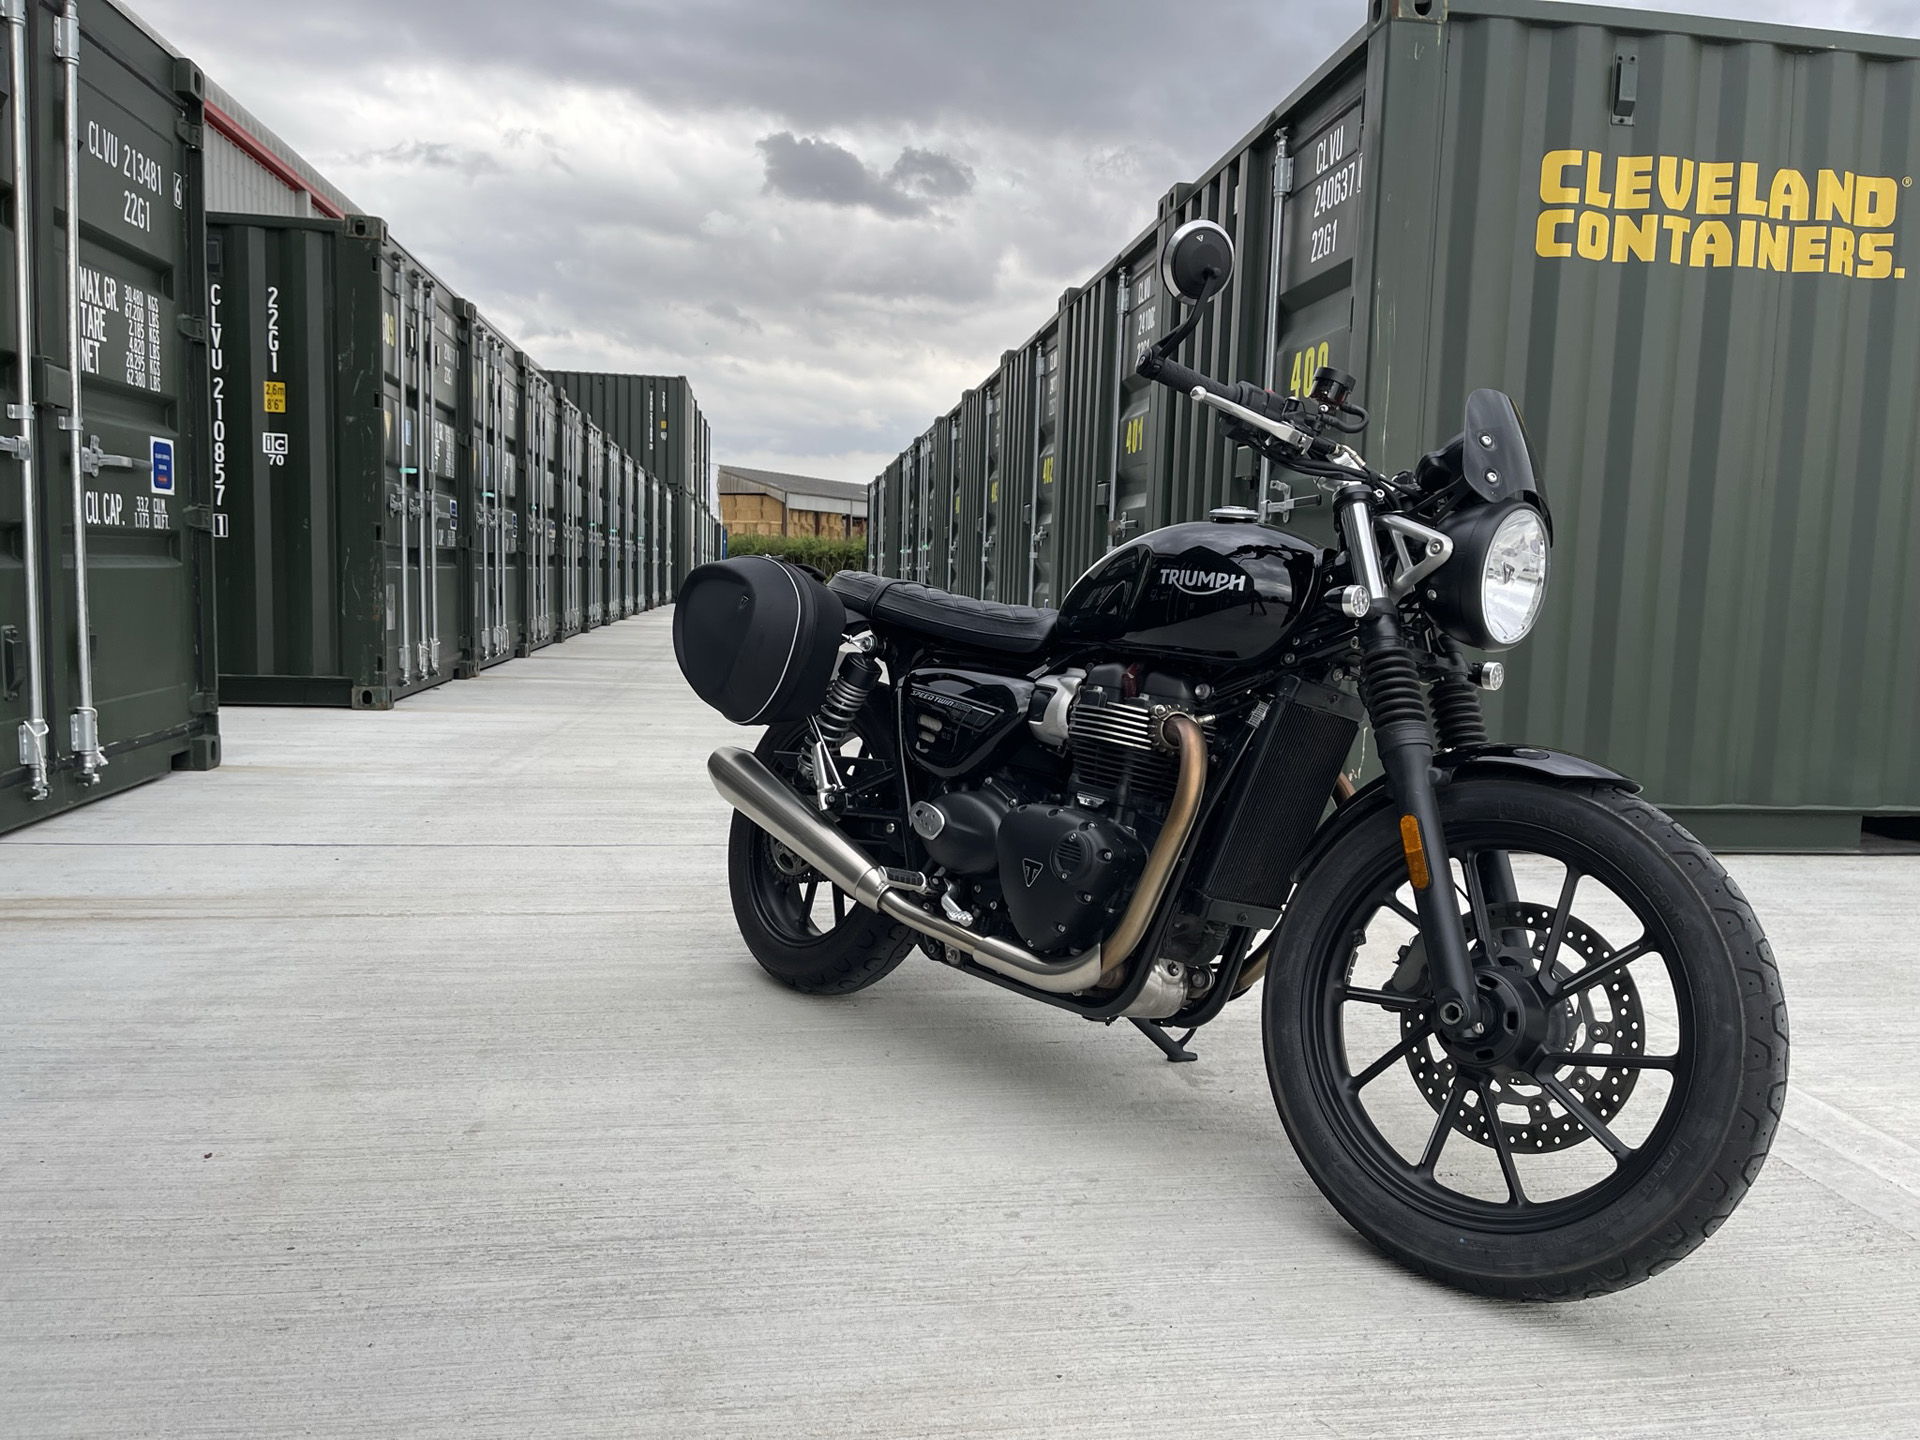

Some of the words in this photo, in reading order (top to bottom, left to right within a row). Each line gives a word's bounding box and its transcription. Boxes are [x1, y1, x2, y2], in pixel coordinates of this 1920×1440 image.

[89, 120, 118, 168] CLVU
[123, 144, 162, 196] 213481
[173, 178, 182, 207] 6
[1316, 125, 1344, 175] CLVU
[123, 190, 150, 233] 22G1
[1313, 161, 1356, 218] 240637
[1539, 149, 1898, 228] CLEVELAND
[1310, 218, 1338, 264] 22G1
[80, 301, 107, 342] TARE
[210, 284, 222, 370] CLVU
[267, 286, 280, 373] 22G1
[81, 337, 100, 375] NET
[213, 377, 226, 506] 210857
[1126, 415, 1144, 454] 401
[268, 454, 285, 466] 70
[1160, 568, 1247, 595] TRIUMPH
[910, 690, 935, 701] SPEED
[934, 695, 954, 707] TWIN
